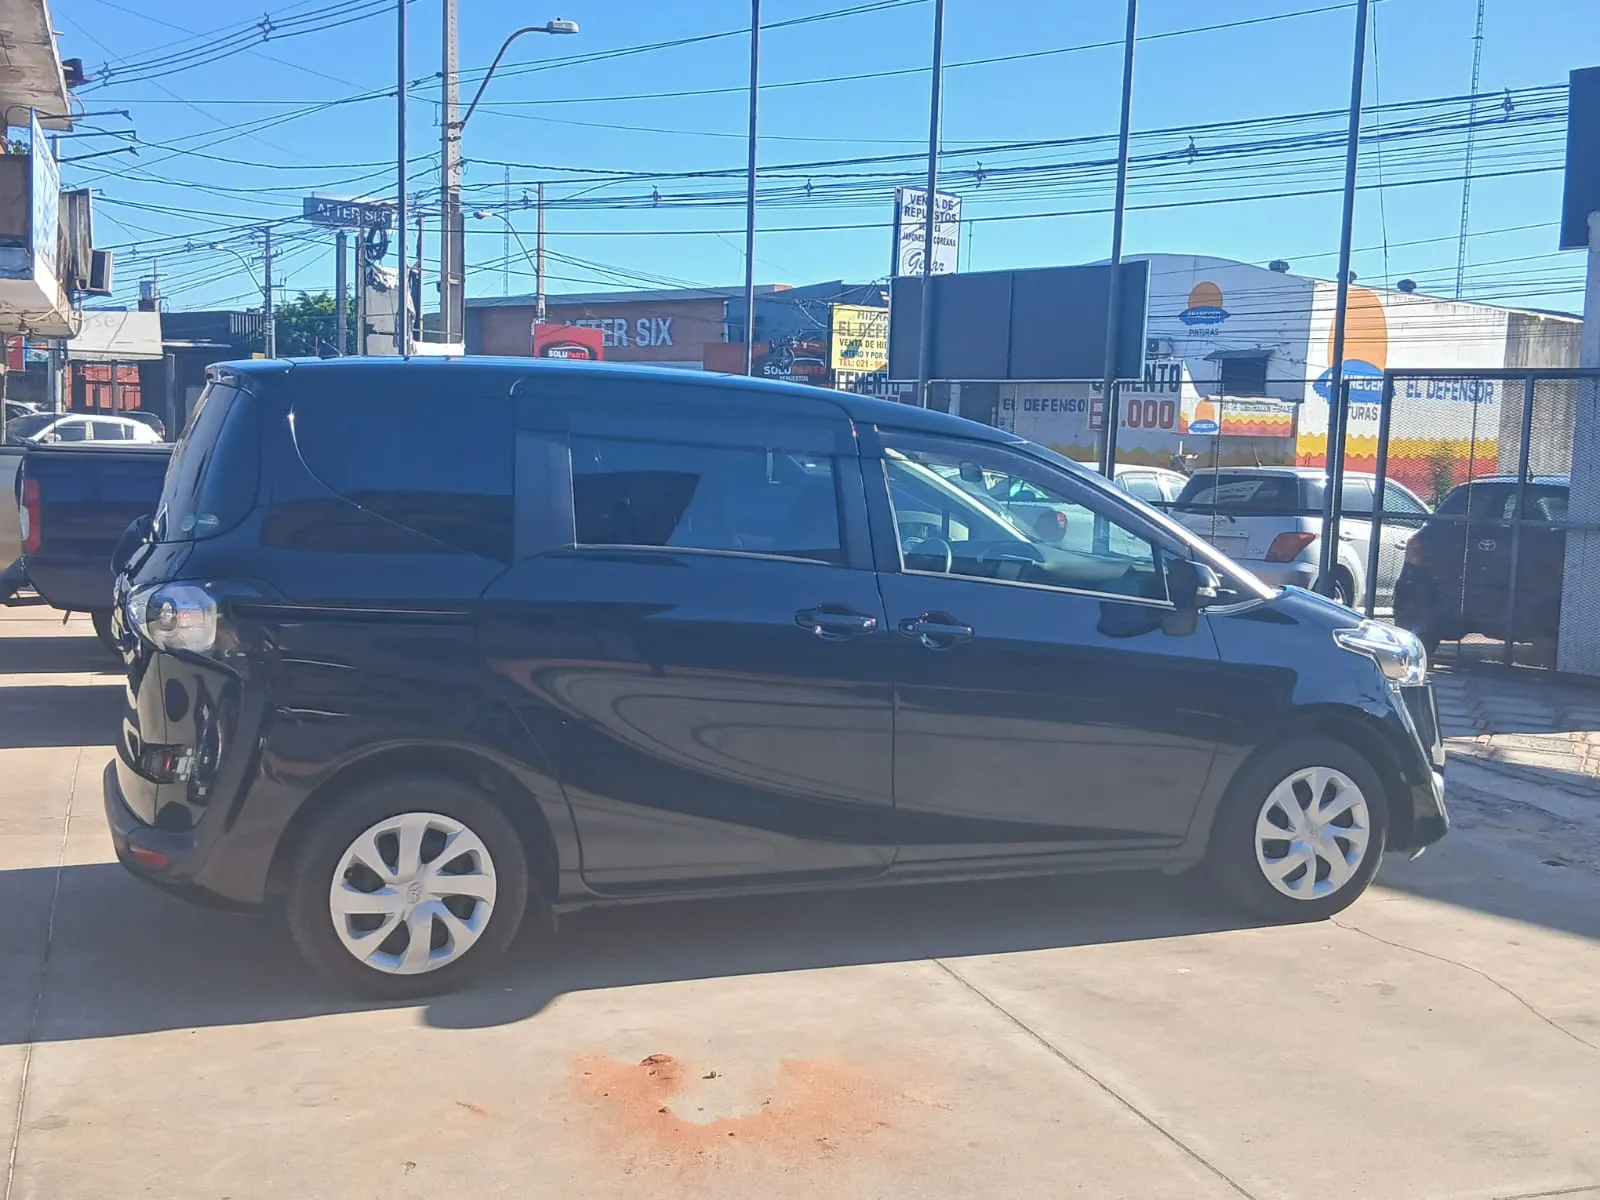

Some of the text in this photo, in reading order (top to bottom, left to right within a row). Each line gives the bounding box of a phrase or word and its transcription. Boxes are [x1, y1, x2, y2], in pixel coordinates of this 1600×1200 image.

[910, 194, 954, 211] VENA DE
[318, 203, 360, 220] AFTER
[904, 206, 957, 224] REPUSTOS
[635, 317, 673, 347] SIX
[838, 320, 852, 337] EL
[839, 338, 863, 348] VENTA
[865, 339, 875, 349] DE
[839, 358, 855, 367] TEL:
[856, 359, 869, 368] 021
[870, 351, 883, 360] POR
[1405, 377, 1494, 404] EL DEFENSOR
[1024, 398, 1089, 413] DEFENSO
